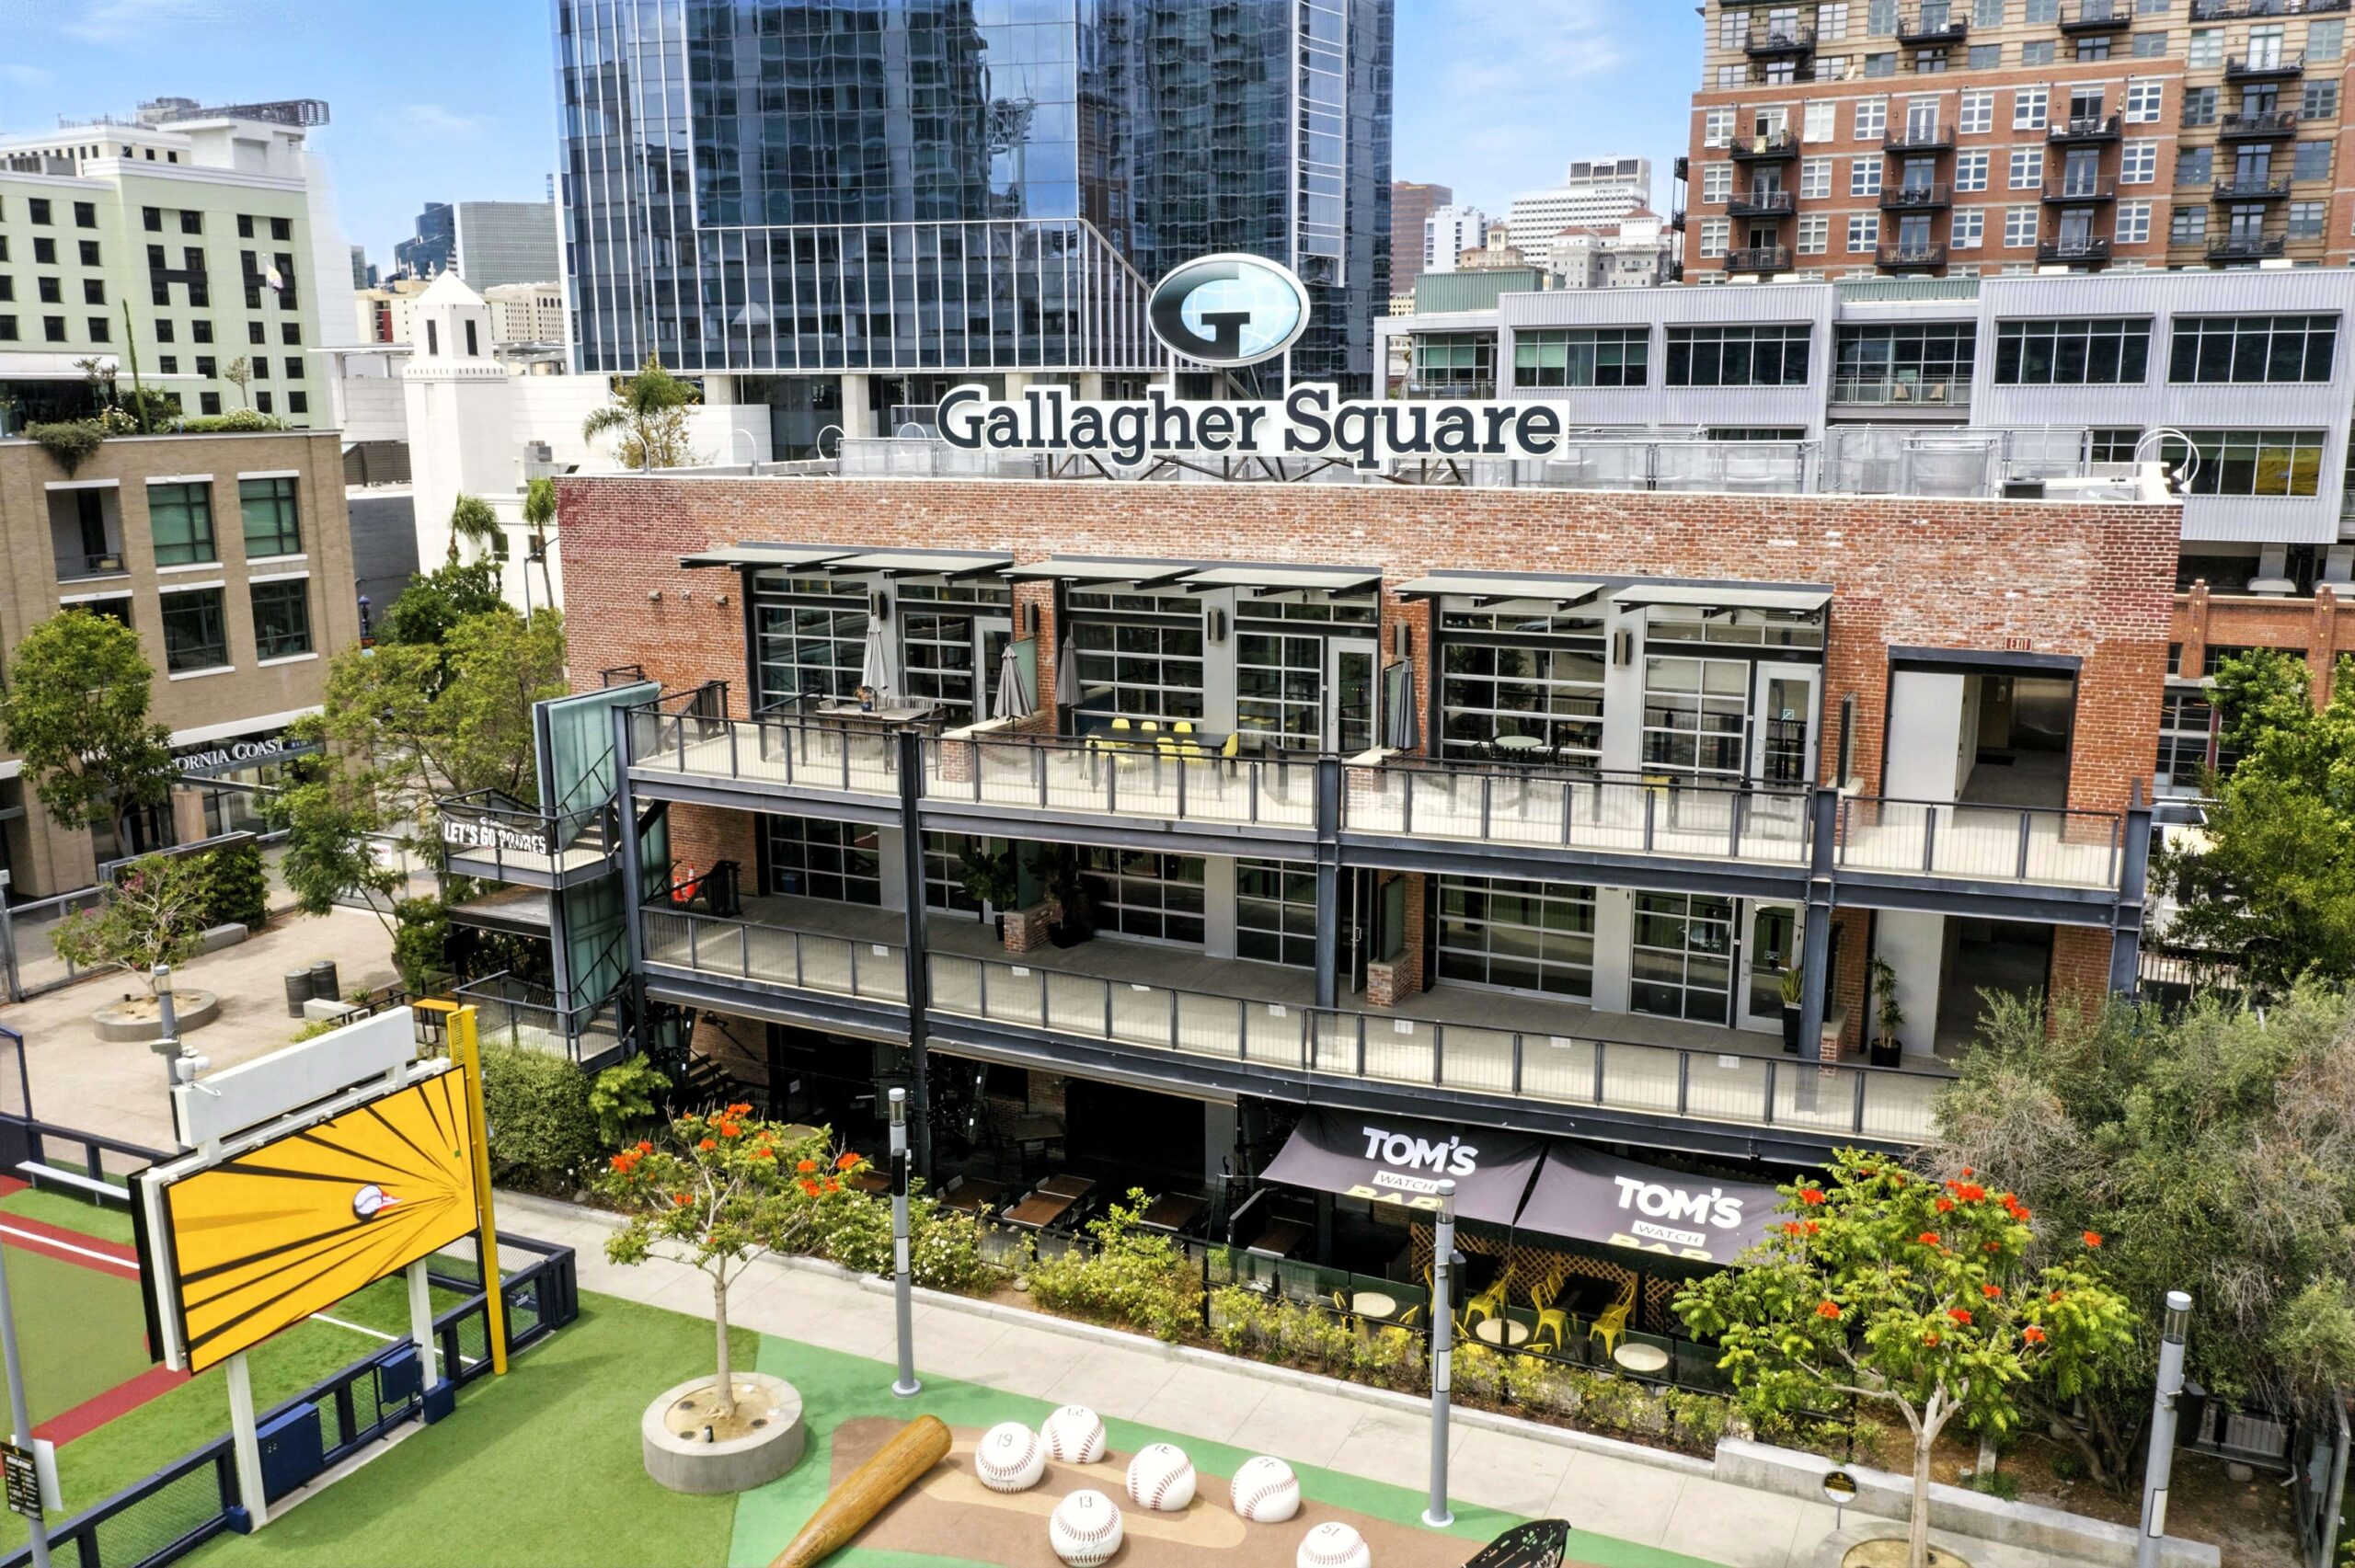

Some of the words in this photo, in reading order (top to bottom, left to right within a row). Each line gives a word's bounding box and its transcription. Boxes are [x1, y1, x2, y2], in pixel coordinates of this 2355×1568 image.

[937, 388, 1267, 466] Gallagher
[1284, 387, 1561, 469] Square
[2010, 638, 2028, 650] EXIT
[172, 749, 230, 773] ORNIA
[232, 738, 284, 761] COAST
[444, 821, 477, 845] LET'S
[480, 826, 497, 847] GO
[498, 830, 546, 854] PADRES
[1362, 1126, 1479, 1176] TOM'S
[1380, 1174, 1434, 1191] WATCH
[1614, 1175, 1744, 1229] TOM'S
[1638, 1224, 1699, 1242] WATCH
[996, 1433, 1013, 1448] 19
[1079, 1495, 1093, 1508] 13
